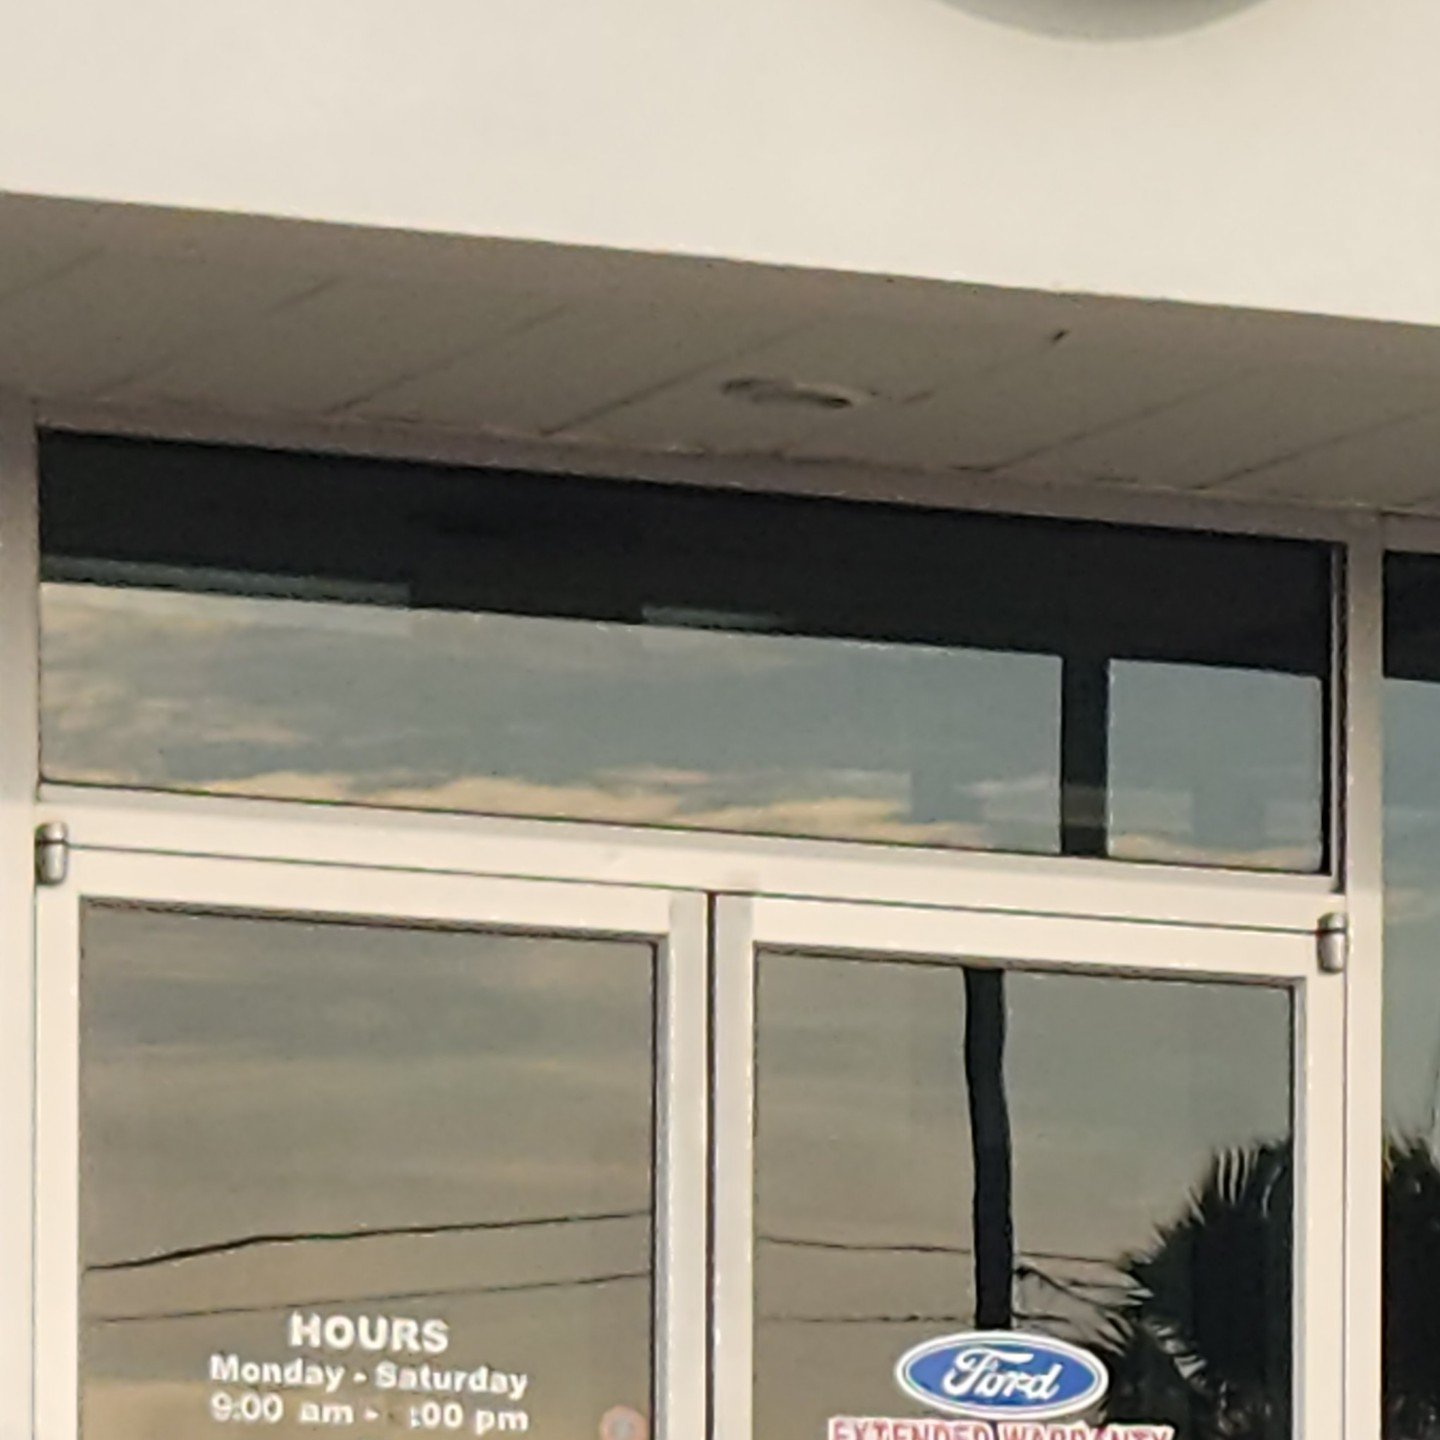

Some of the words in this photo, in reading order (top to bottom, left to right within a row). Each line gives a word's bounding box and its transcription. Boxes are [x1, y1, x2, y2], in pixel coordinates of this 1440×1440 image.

[288, 1312, 450, 1354] HOURS
[209, 1354, 345, 1391] Monday
[375, 1361, 528, 1400] Saturday
[941, 1348, 1063, 1399] Ford
[211, 1392, 284, 1423] 9:00
[300, 1402, 354, 1423] am
[475, 1408, 529, 1435] pm
